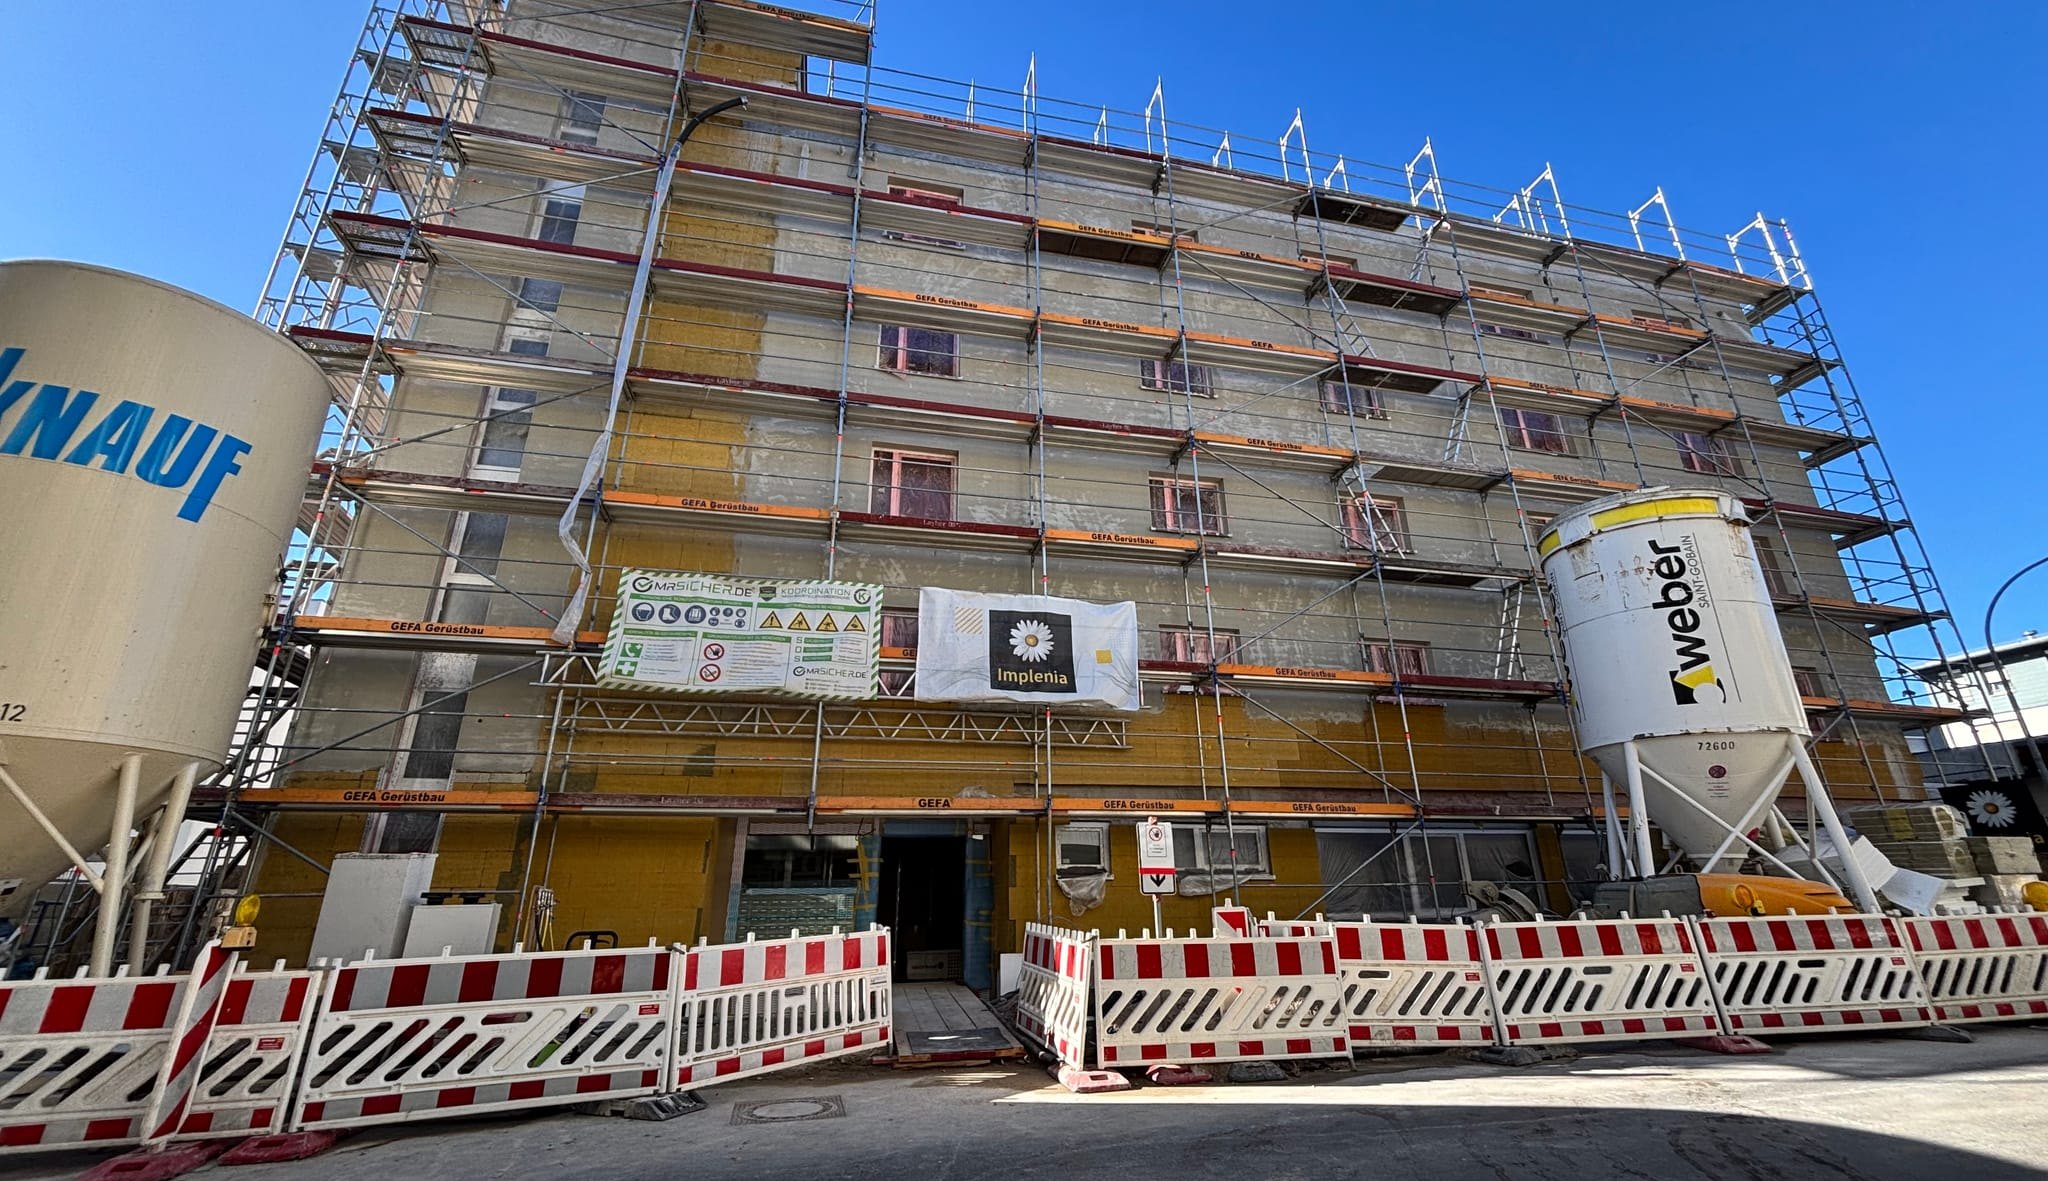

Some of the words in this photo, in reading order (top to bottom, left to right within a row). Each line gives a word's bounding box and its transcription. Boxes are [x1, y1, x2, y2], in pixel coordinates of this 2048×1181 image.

[1078, 225, 1096, 233] GEFA
[1098, 227, 1133, 238] Gerüstbau
[1240, 250, 1260, 259] GEFA
[916, 294, 935, 302] GEFA
[938, 296, 977, 308] Gerüstbau
[1082, 318, 1100, 326] GEFA
[1102, 320, 1139, 331] Gerüstbau
[1251, 340, 1273, 349] GEFA
[1247, 438, 1265, 446] GEFA
[1267, 440, 1302, 450] Gerüstbau
[681, 498, 706, 508] GEFA
[710, 500, 759, 512] Gerüstbau
[1091, 533, 1112, 542] GEFA
[1114, 534, 1154, 545] Gerüstbau
[1680, 535, 1709, 608] SAINT-GOBAIN
[781, 587, 851, 597] KOORDINATION
[1648, 539, 1710, 672] weber
[390, 622, 421, 632] GEFA
[425, 622, 484, 635] Gerüstbau
[902, 649, 915, 657] GE
[998, 668, 1068, 686] Implenia
[1275, 668, 1296, 676] GEFA
[1298, 668, 1336, 679] Gerüstbau
[1697, 741, 1735, 751] 72600
[343, 791, 376, 801] GEFA
[381, 791, 445, 802] Gerüstbau
[918, 798, 951, 808] GEFA
[1104, 800, 1126, 809] GEFA
[1129, 799, 1174, 810] Gerüstbau
[1292, 803, 1313, 812] GEFA
[1315, 803, 1356, 813] Gerüstbau
